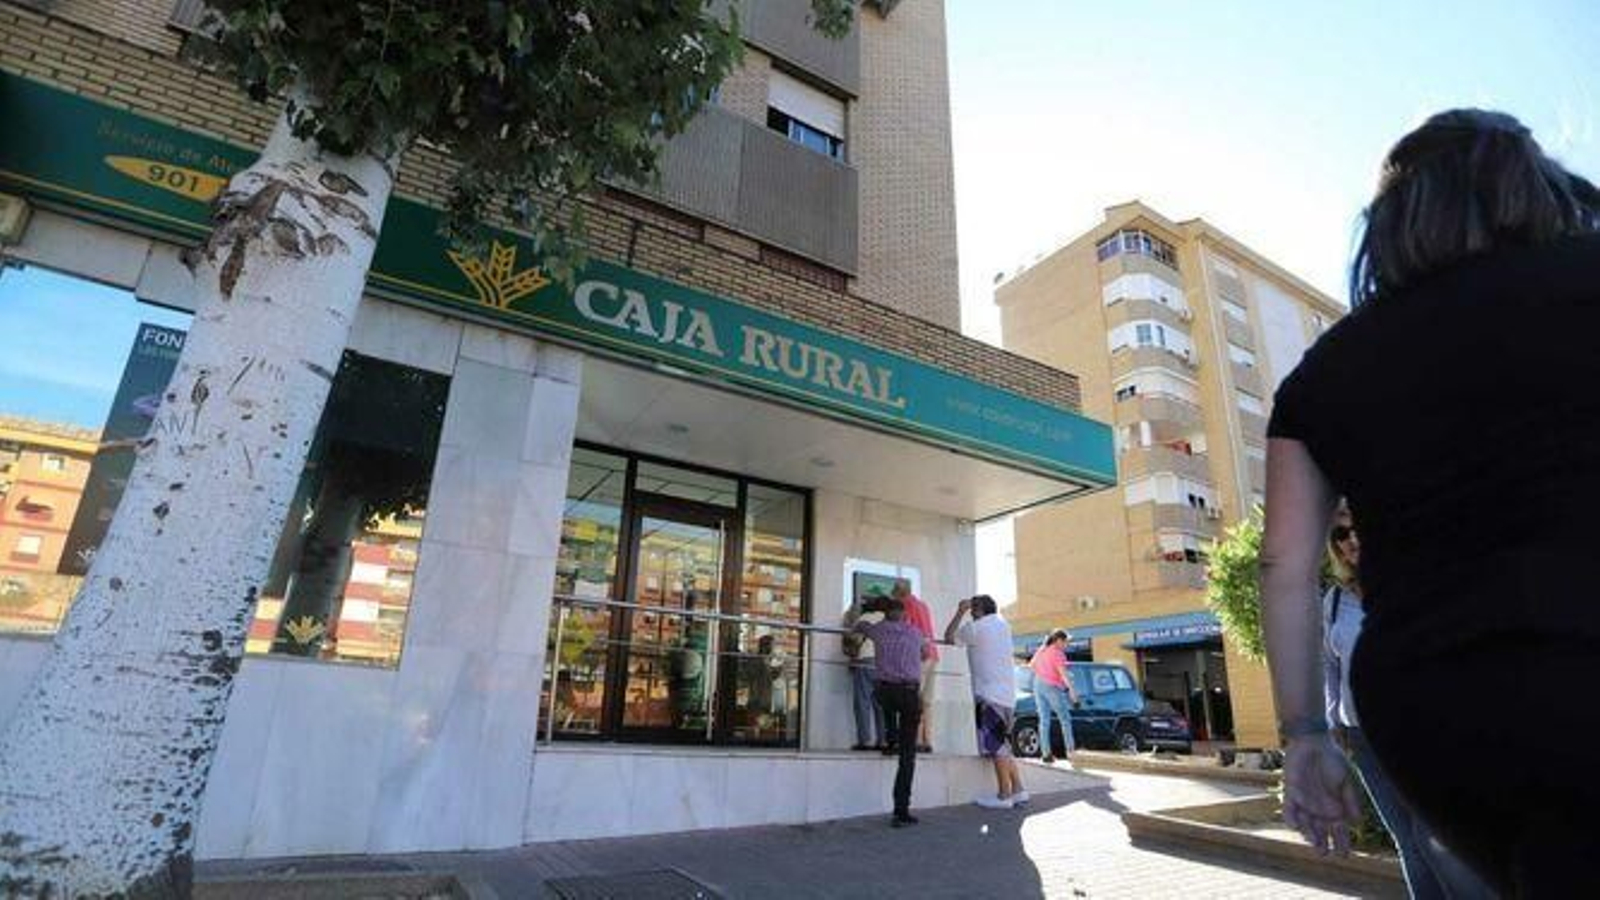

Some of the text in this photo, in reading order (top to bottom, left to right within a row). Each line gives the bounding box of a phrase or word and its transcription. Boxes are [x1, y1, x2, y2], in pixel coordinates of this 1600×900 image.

[149, 165, 199, 192] 901
[573, 279, 906, 409] CAJA RURAL
